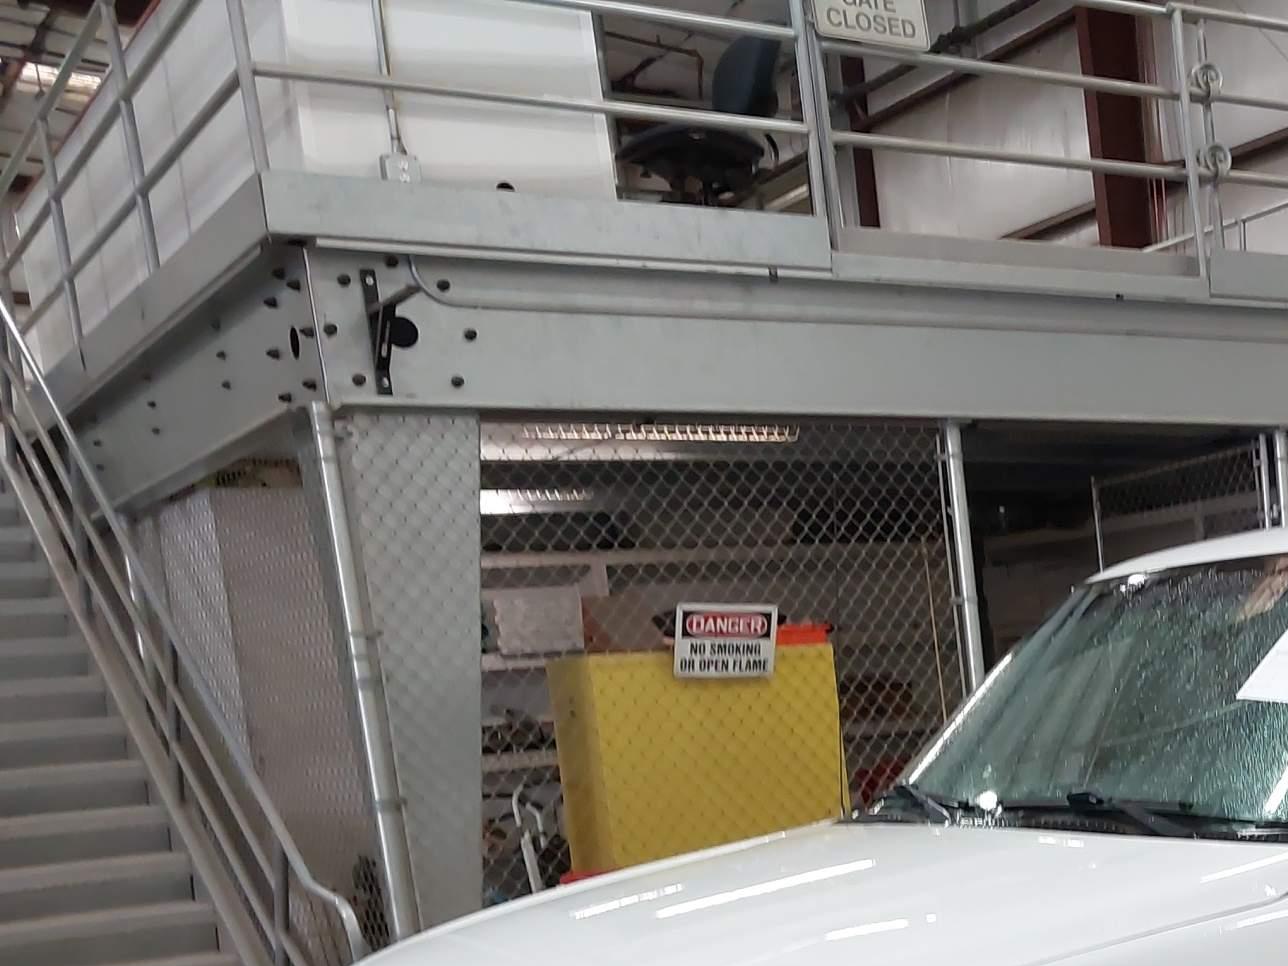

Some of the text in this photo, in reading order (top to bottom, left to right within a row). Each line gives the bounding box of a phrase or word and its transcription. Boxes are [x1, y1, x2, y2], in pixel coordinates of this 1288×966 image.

[842, 0, 897, 13] TE
[826, 8, 916, 38] CLOSED
[692, 616, 762, 634] DANGER
[690, 642, 761, 657] NO SMOKING
[680, 658, 769, 673] OR OPEN FLAME
